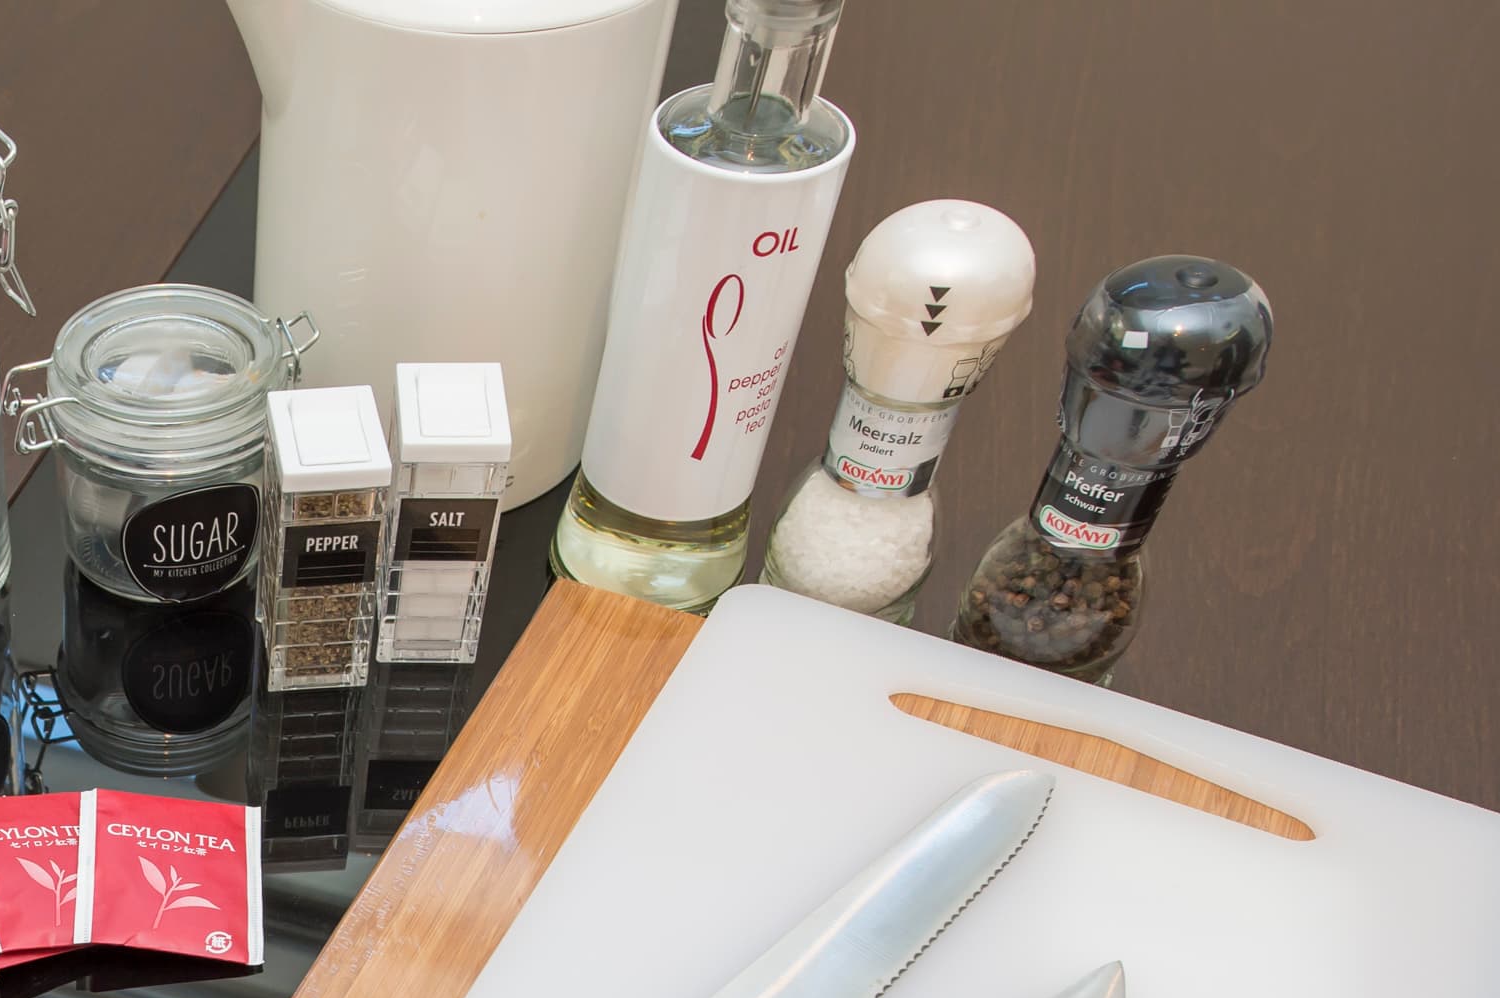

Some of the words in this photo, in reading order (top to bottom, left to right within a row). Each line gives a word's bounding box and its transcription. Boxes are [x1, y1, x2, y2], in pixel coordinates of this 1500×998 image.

[752, 226, 799, 258] OIL
[728, 362, 783, 393] pepper
[756, 378, 778, 400] salt
[735, 398, 772, 425] pasta
[744, 415, 766, 435] tea
[848, 415, 924, 446] Meersalz
[859, 441, 895, 457] jodiert
[842, 461, 905, 486] KOTÁNYI
[1064, 470, 1125, 504] Pfeffer
[1064, 493, 1107, 515] schwarz
[428, 511, 466, 529] SALT
[1045, 511, 1111, 545] KOTÁNYI
[152, 511, 239, 563] SUGAR
[305, 534, 359, 553] PEPPER
[153, 569, 164, 578] MY
[168, 567, 197, 578] KITCHEN
[200, 554, 238, 575] COLLECTION
[60, 825, 80, 838] TE
[106, 823, 191, 844] CEYLON
[195, 833, 236, 853] TEA
[136, 839, 208, 857] セイロン紅茶
